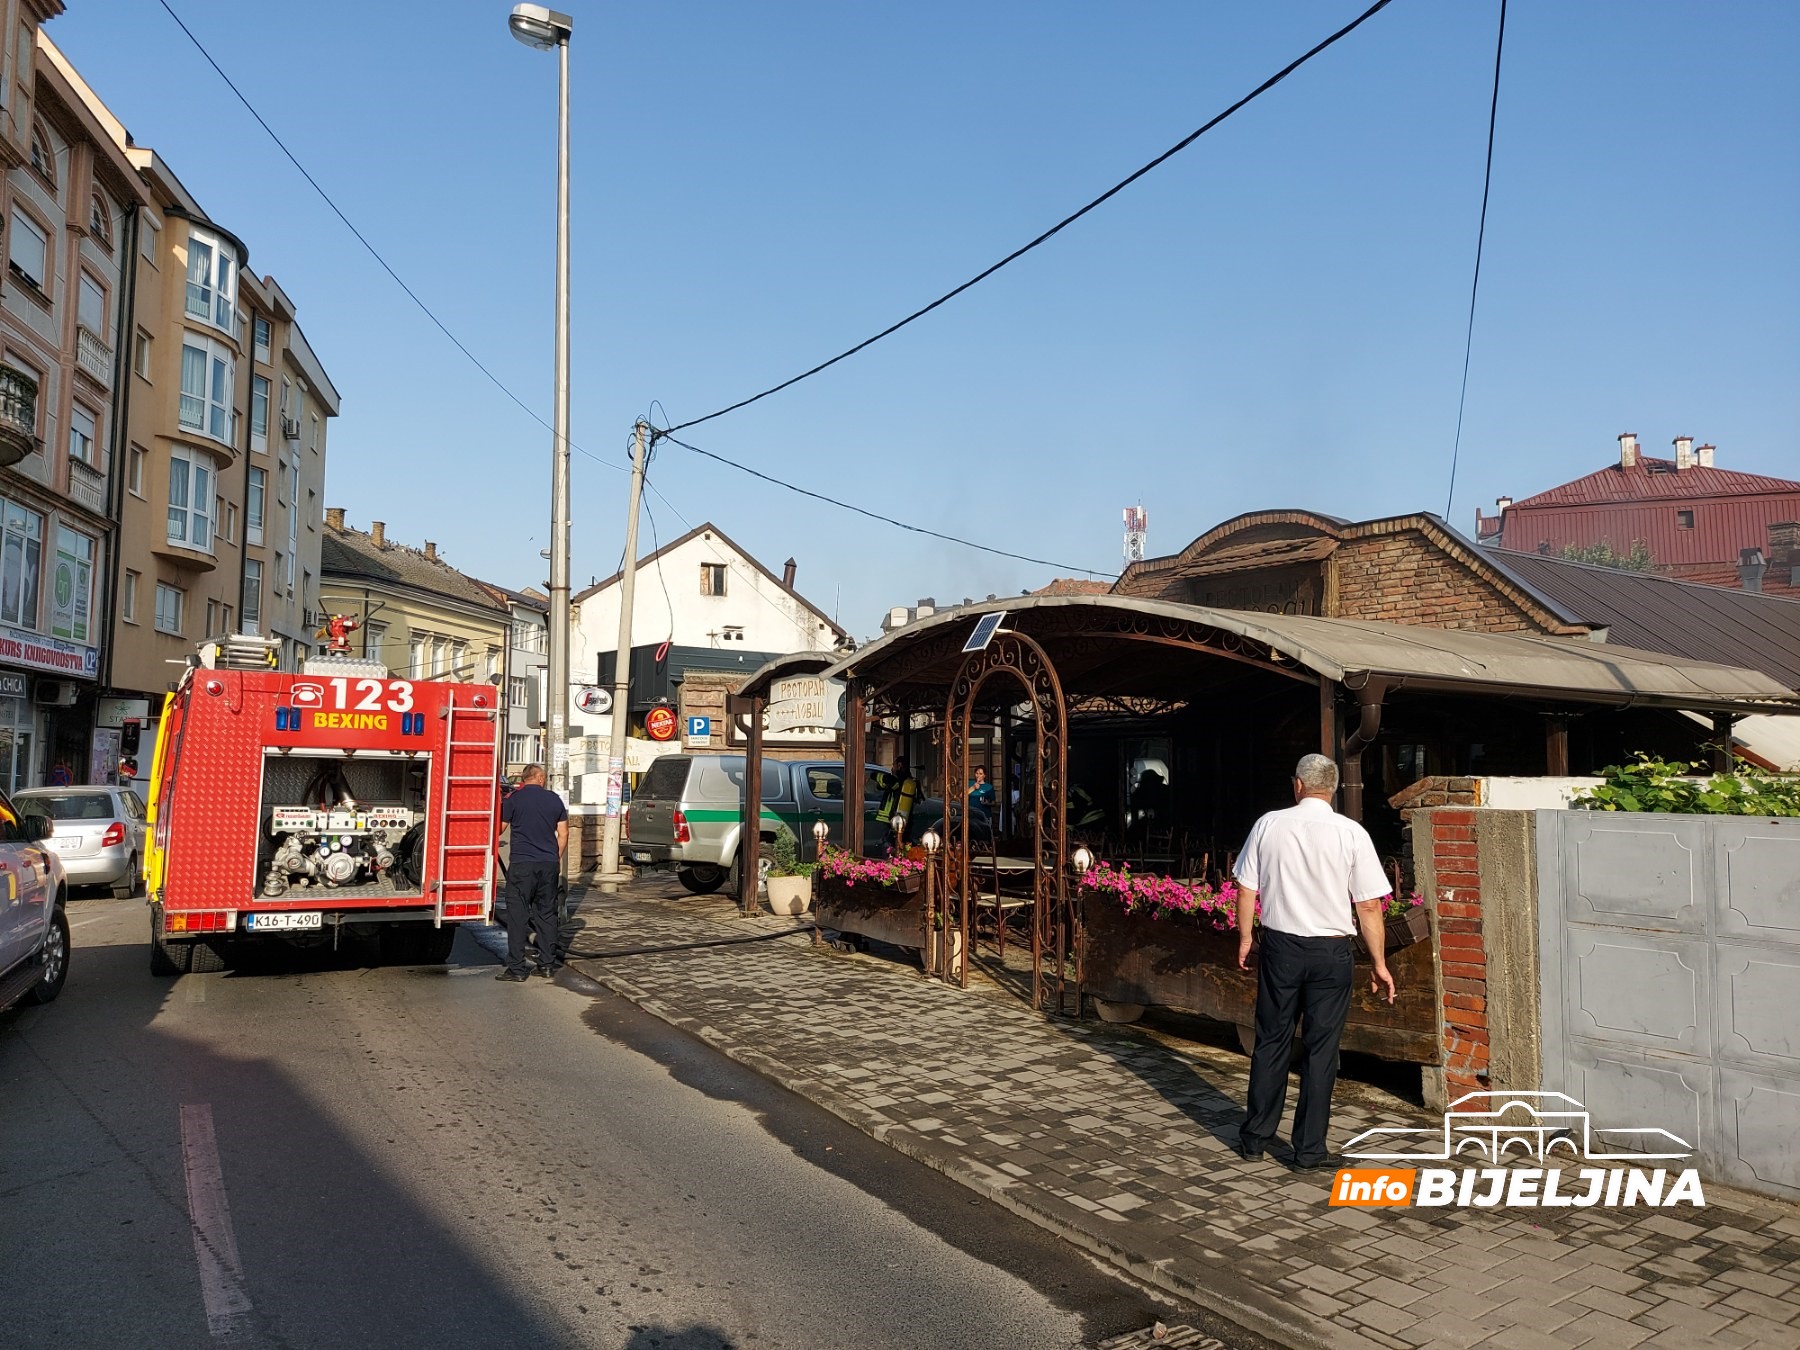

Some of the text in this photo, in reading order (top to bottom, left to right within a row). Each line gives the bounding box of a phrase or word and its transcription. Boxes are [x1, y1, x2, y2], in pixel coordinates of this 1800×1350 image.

[24, 643, 83, 671] KNJIGOVODSTVA
[2, 677, 23, 693] CHICA
[329, 678, 414, 713] 123
[314, 712, 388, 730] BEXING
[651, 718, 673, 730] NEKTAR
[693, 718, 705, 734] P
[255, 914, 319, 927] K16-T-490
